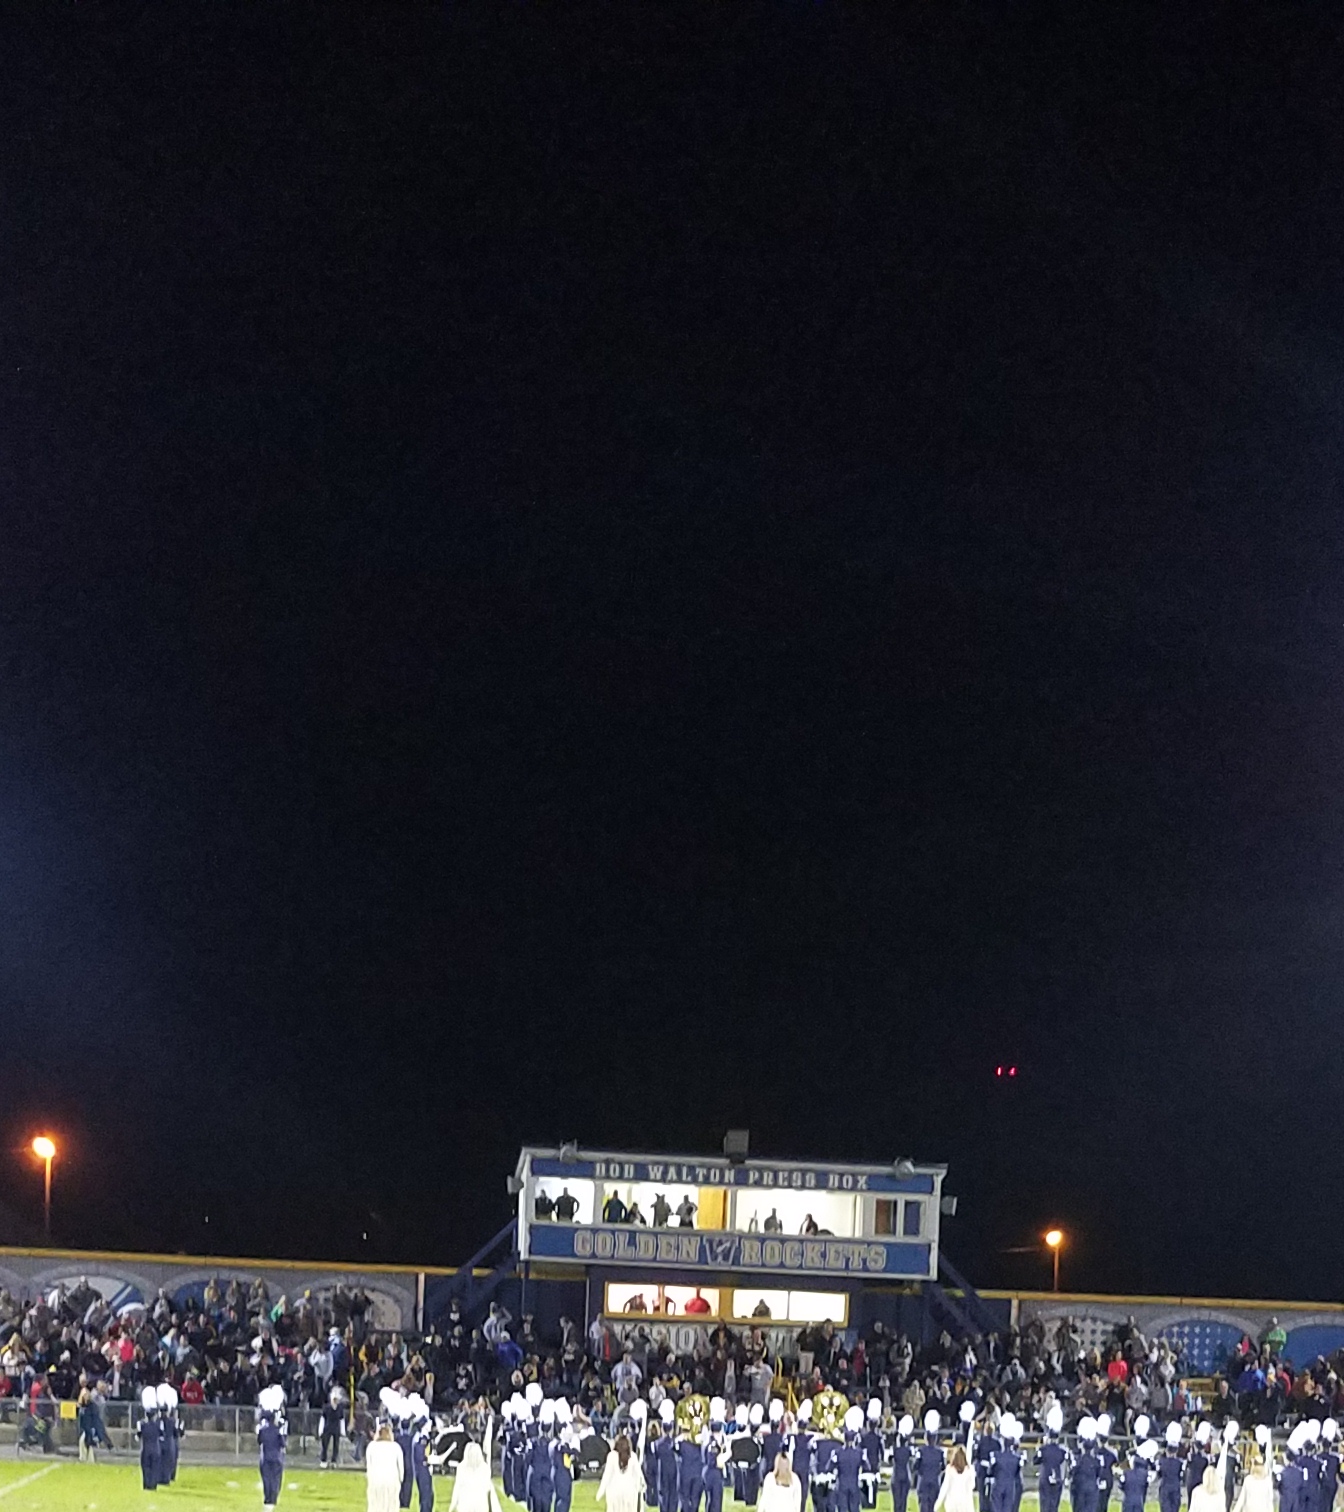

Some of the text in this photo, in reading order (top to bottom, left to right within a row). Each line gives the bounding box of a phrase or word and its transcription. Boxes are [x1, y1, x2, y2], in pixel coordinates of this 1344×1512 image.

[647, 1164, 736, 1183] WALTON
[748, 1169, 817, 1189] PRESS
[828, 1174, 869, 1190] BOX
[574, 1229, 701, 1262] GOLDEN
[740, 1239, 887, 1272] ROCKETS
